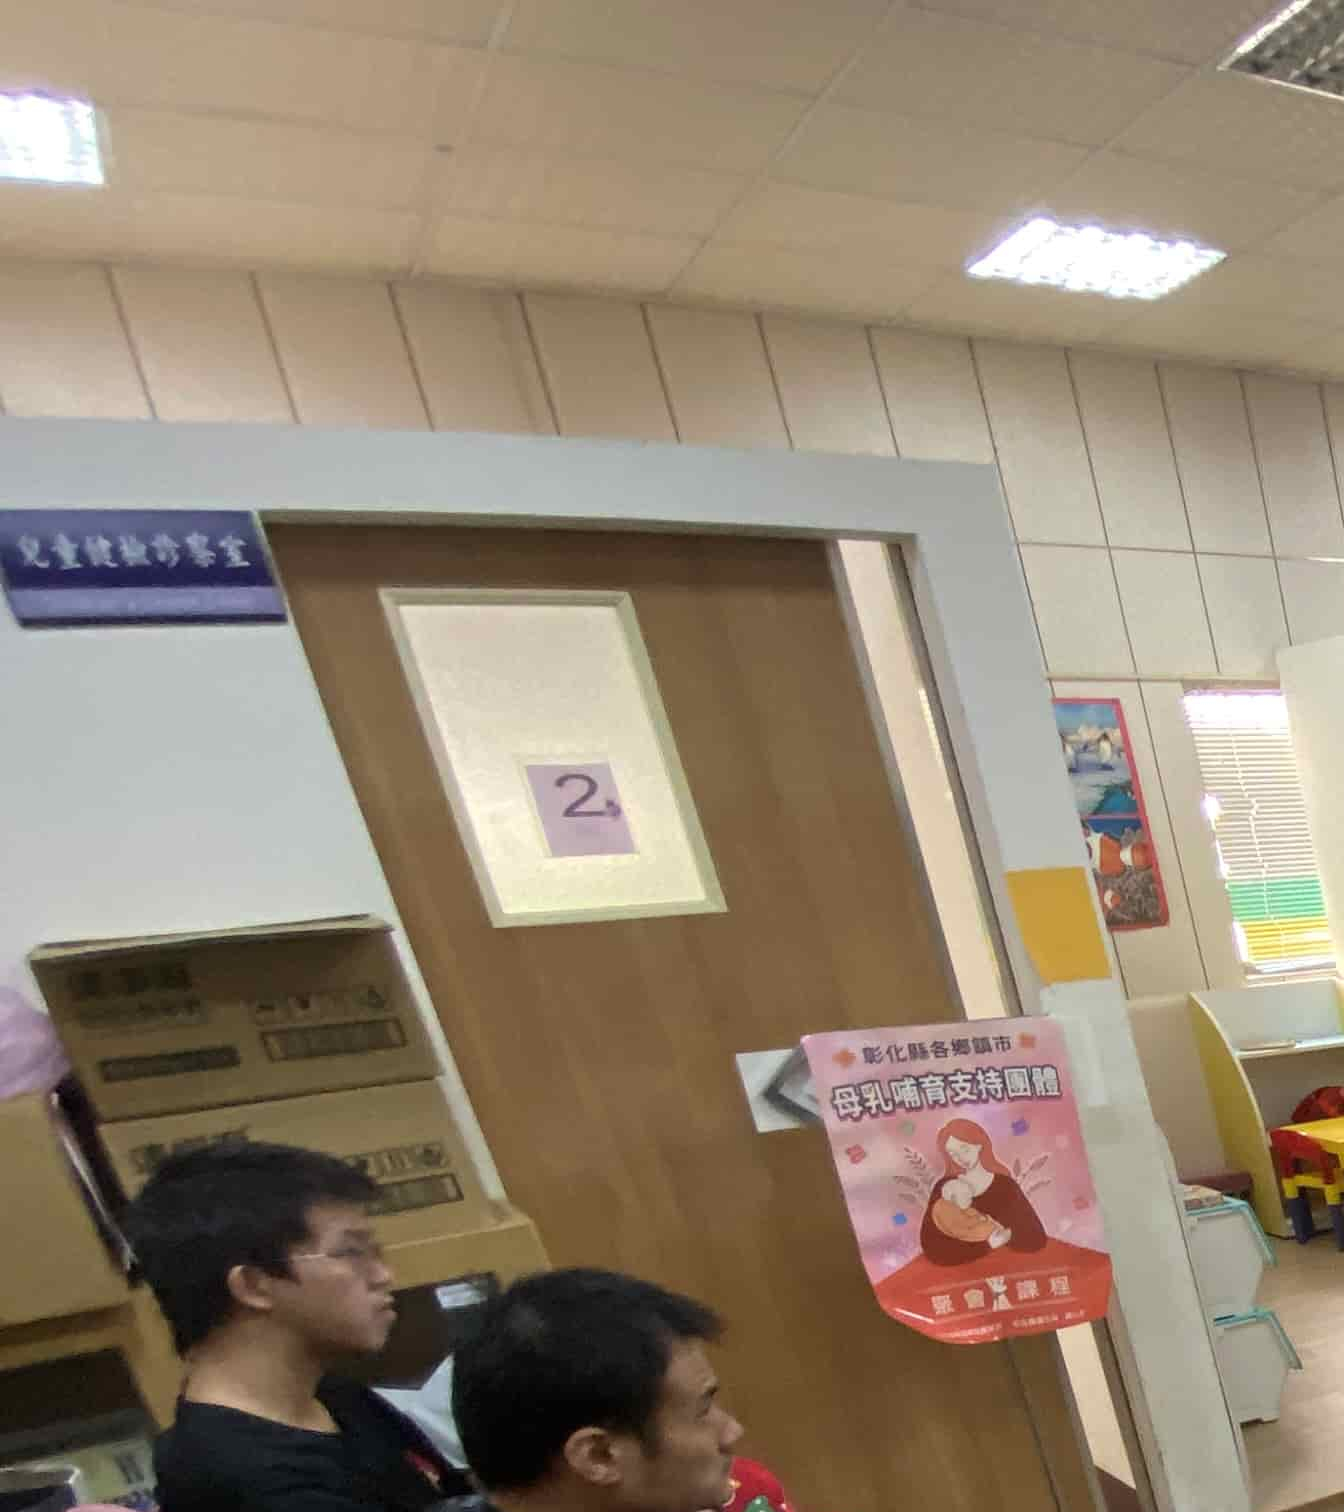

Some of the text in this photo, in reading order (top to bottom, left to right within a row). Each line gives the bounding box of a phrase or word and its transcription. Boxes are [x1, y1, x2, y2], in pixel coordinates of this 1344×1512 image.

[862, 1035, 1012, 1064] 彰化縣各鄉鎮市
[832, 1065, 1062, 1120] 母乳哺育支持團體
